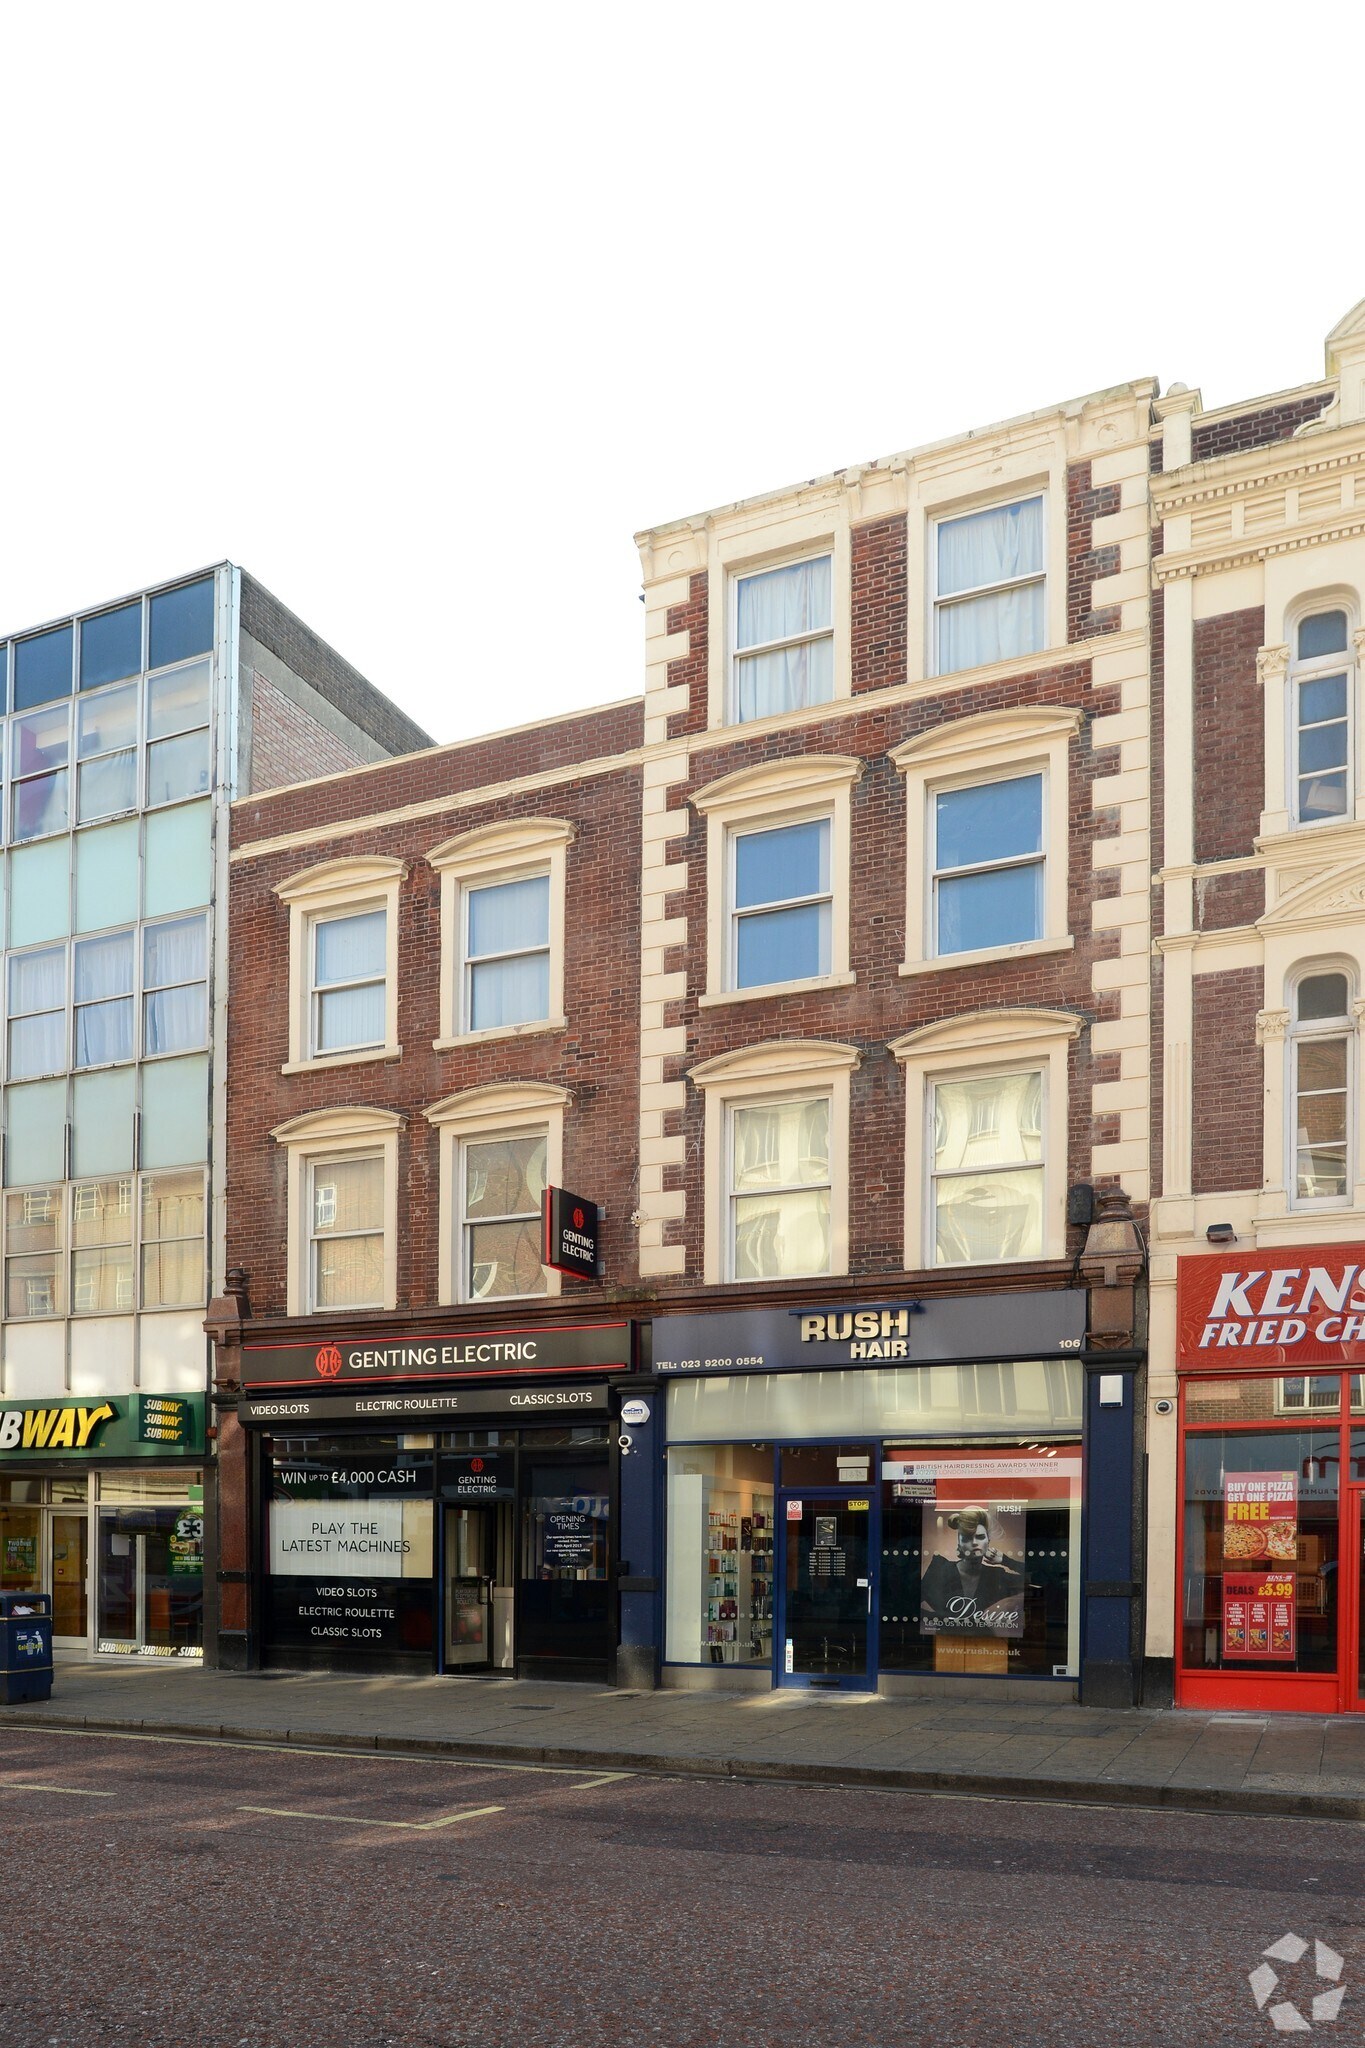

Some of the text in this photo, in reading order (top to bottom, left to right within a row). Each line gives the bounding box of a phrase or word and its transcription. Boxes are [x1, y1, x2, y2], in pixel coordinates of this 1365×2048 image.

[563, 1229, 594, 1249] GENTING
[562, 1242, 594, 1262] ELECTRIC
[801, 1309, 909, 1342] RUSH
[1198, 1319, 1306, 1348] FRIED
[850, 1340, 908, 1359] HAIR
[1059, 1339, 1081, 1349] 106
[349, 1341, 537, 1369] GENTING ELECTRIC
[656, 1356, 764, 1369] TEL: 023 9200 0554
[355, 1398, 458, 1411] ELECTRIC ROULETTE
[509, 1392, 592, 1406] CLASSIC SLOTS
[144, 1399, 182, 1413] SUBWAY
[250, 1404, 310, 1415] VIDEO SLOTS
[0, 1401, 114, 1448] BWAY
[144, 1413, 182, 1427] SUBWAY
[144, 1427, 182, 1441] SUBWAY
[281, 1472, 307, 1484] WIN
[331, 1471, 374, 1486] £4,000
[377, 1470, 416, 1483] CASH
[458, 1475, 497, 1485] GENTING
[457, 1485, 497, 1494] ELECTRIC
[1227, 1482, 1247, 1492] BUY
[1247, 1482, 1266, 1492] ONE
[1267, 1481, 1293, 1491] PIZZA
[1227, 1492, 1293, 1502] GET ONE PIZZA
[997, 1505, 1022, 1513] RUSH
[1227, 1503, 1270, 1521] FREE
[550, 1515, 586, 1523] OPENING
[312, 1522, 378, 1535] PLAY THE
[282, 1540, 411, 1552] LATEST MACHINES
[316, 1587, 377, 1598] VIDEO SLOTS
[1226, 1583, 1293, 1596] DEALS £3.99
[299, 1606, 395, 1619] ELECTRIC ROULETTE
[946, 1596, 1019, 1622] Desire
[975, 1621, 1019, 1629] TEMPTATION
[311, 1626, 382, 1638] CLASSIC SLOTS
[99, 1642, 136, 1654] SUBWAY
[137, 1645, 176, 1657] SUBWAY
[936, 1647, 1021, 1656] www.rush.co.uk
